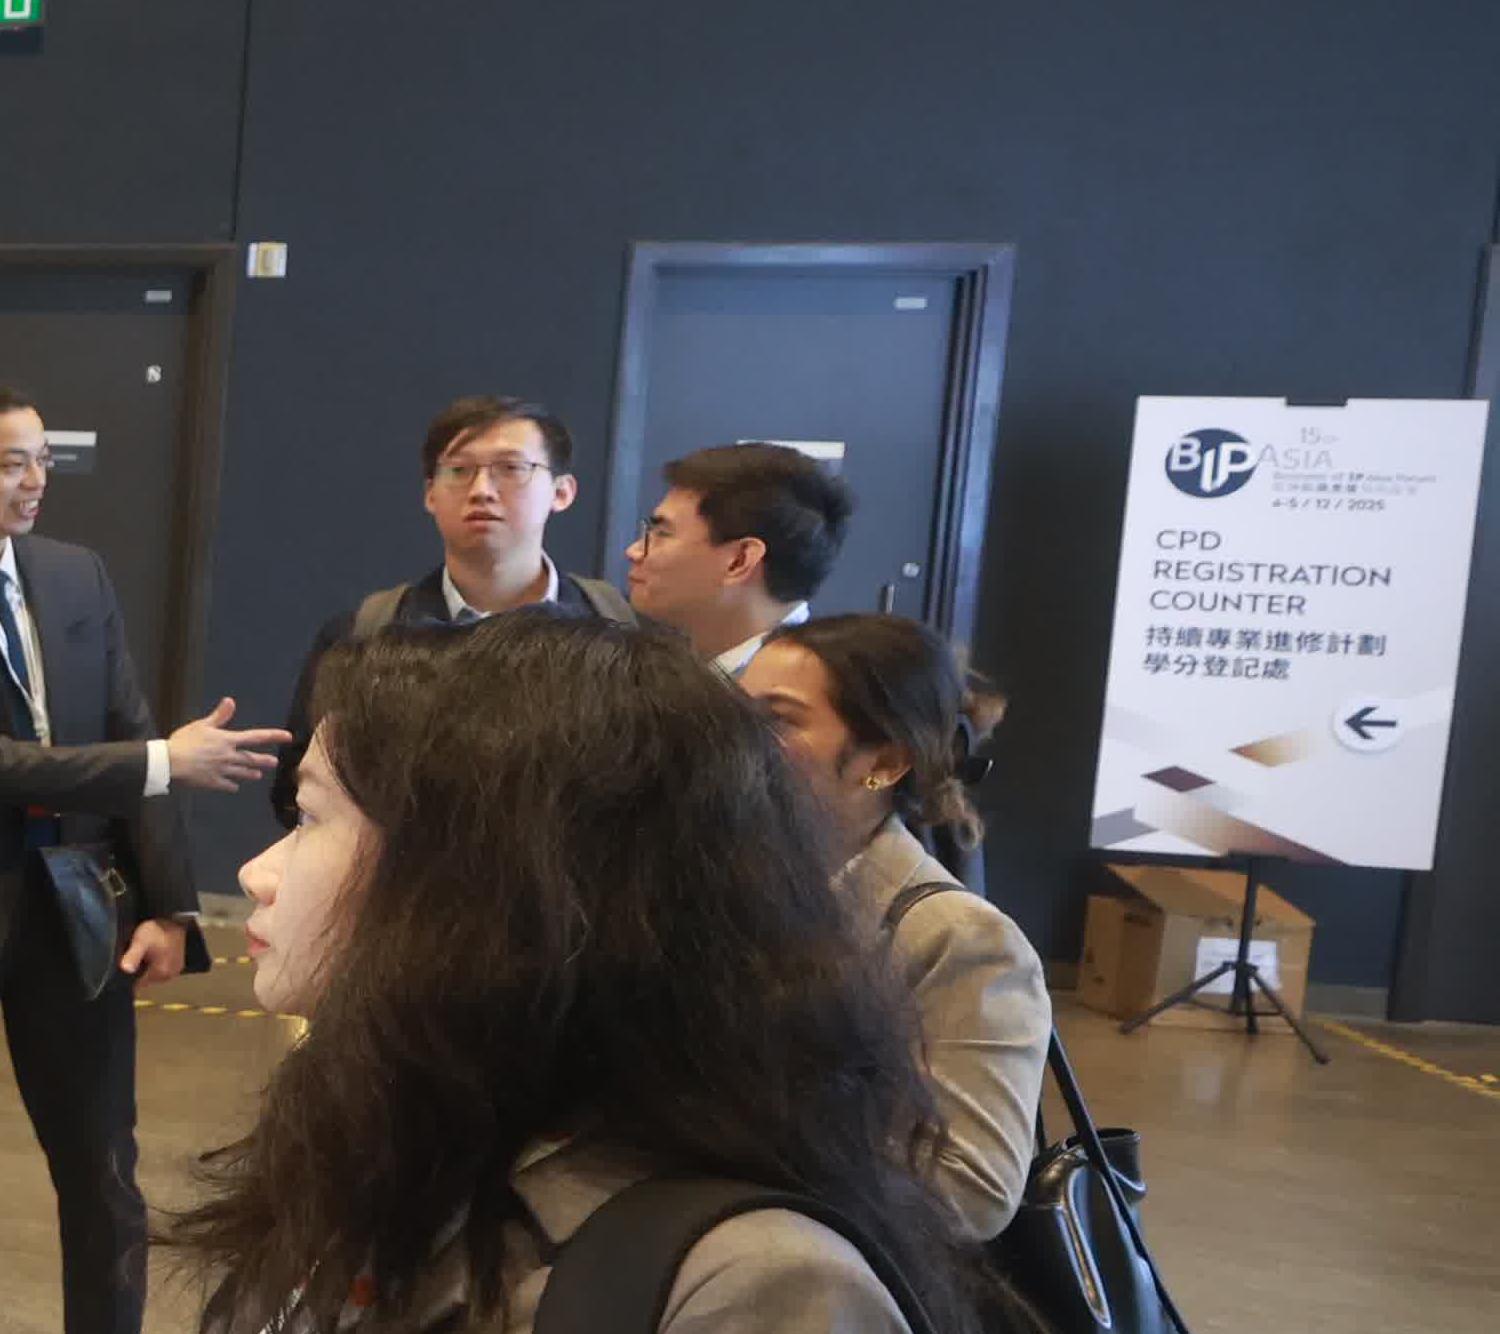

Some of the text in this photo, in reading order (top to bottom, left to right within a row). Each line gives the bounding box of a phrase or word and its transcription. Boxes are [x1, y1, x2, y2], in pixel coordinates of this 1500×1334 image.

[1259, 443, 1335, 469] ASIA
[1155, 529, 1223, 552] CPD
[1152, 560, 1393, 589] REGISTRATION
[1148, 589, 1308, 616] COUNTER
[1144, 624, 1388, 658] 持續專業進修計劃
[1142, 650, 1291, 681] 學分登記處
